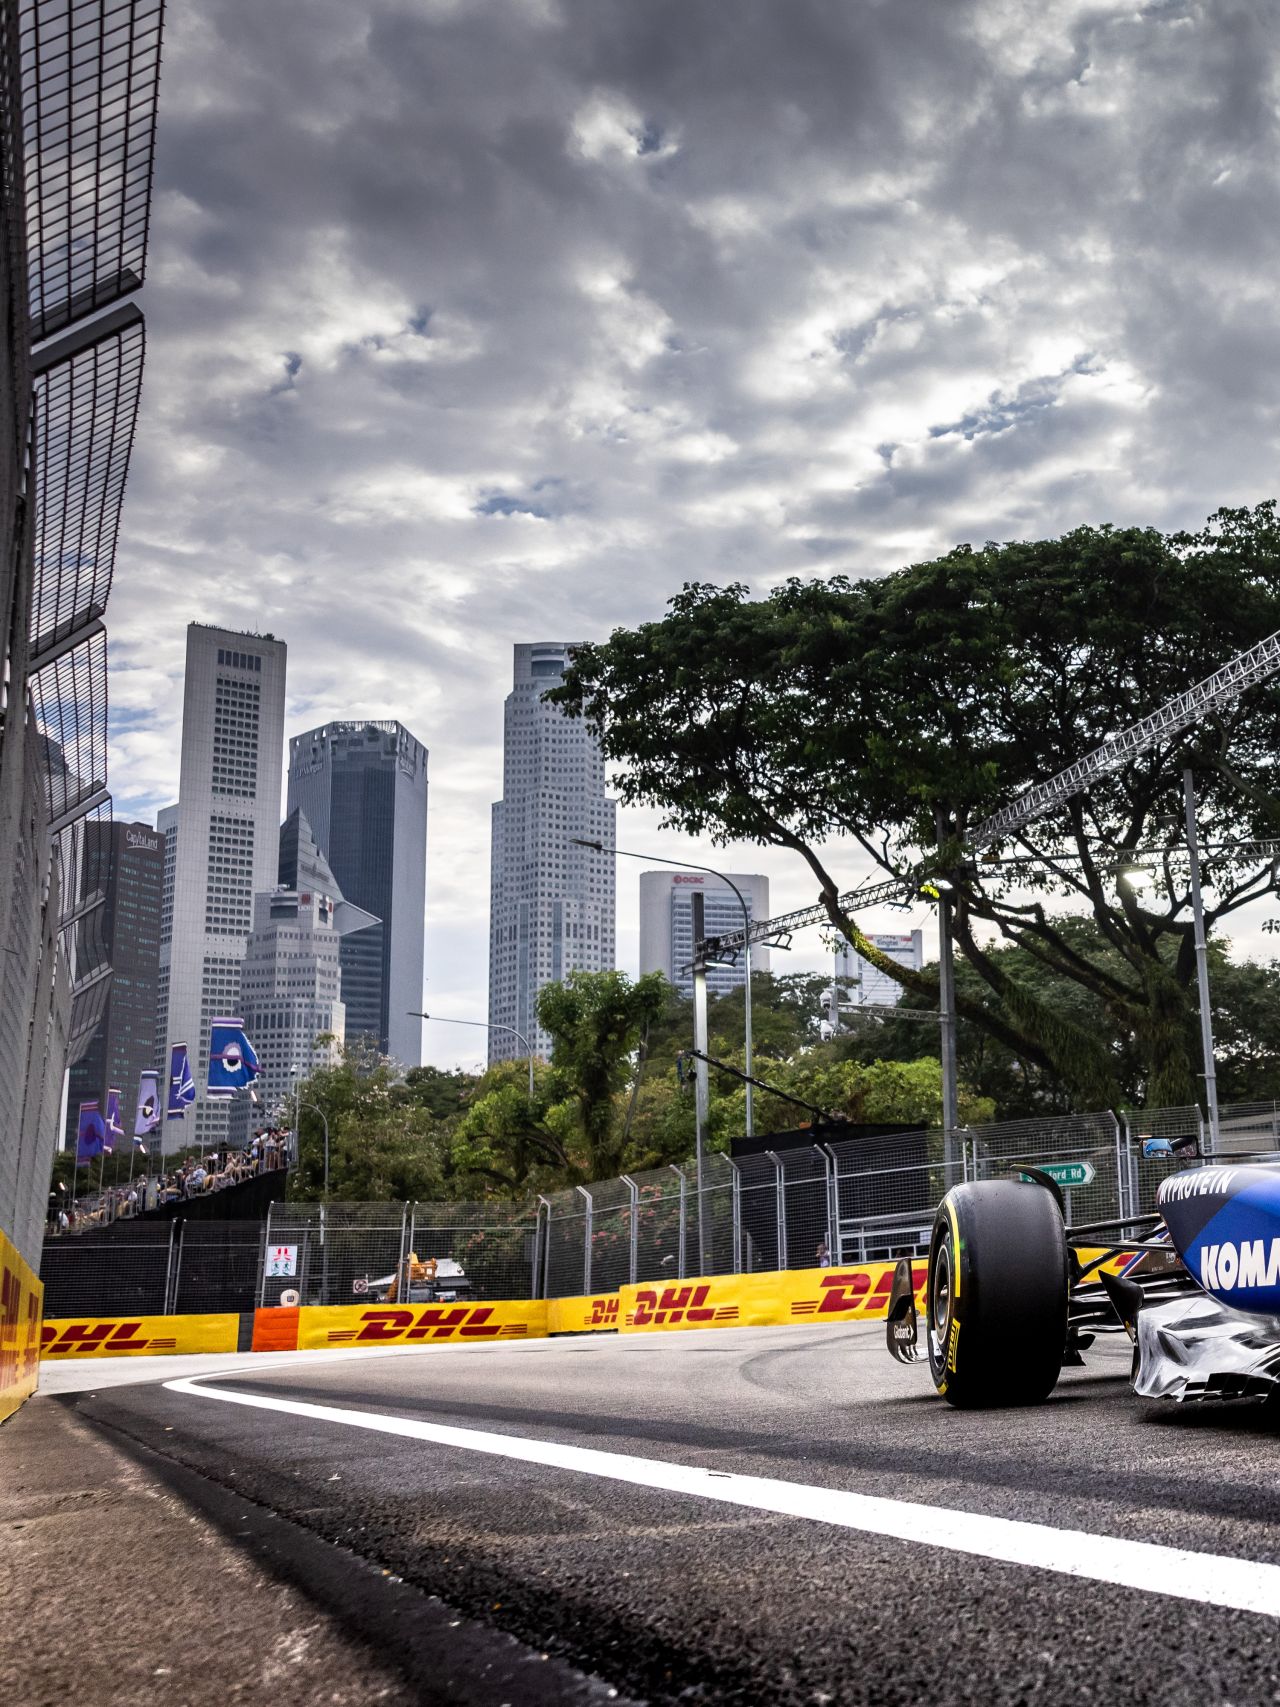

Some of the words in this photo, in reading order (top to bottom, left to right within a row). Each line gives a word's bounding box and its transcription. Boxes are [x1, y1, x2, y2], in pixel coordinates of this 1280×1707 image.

[126, 830, 158, 849] CapitaLand
[1071, 1168, 1082, 1178] Rd
[1159, 1171, 1239, 1205] MYPROTEIN
[591, 1299, 620, 1324] DH
[632, 1285, 717, 1325] DHL
[355, 1307, 502, 1341] DHL
[893, 1324, 910, 1339] Globant
